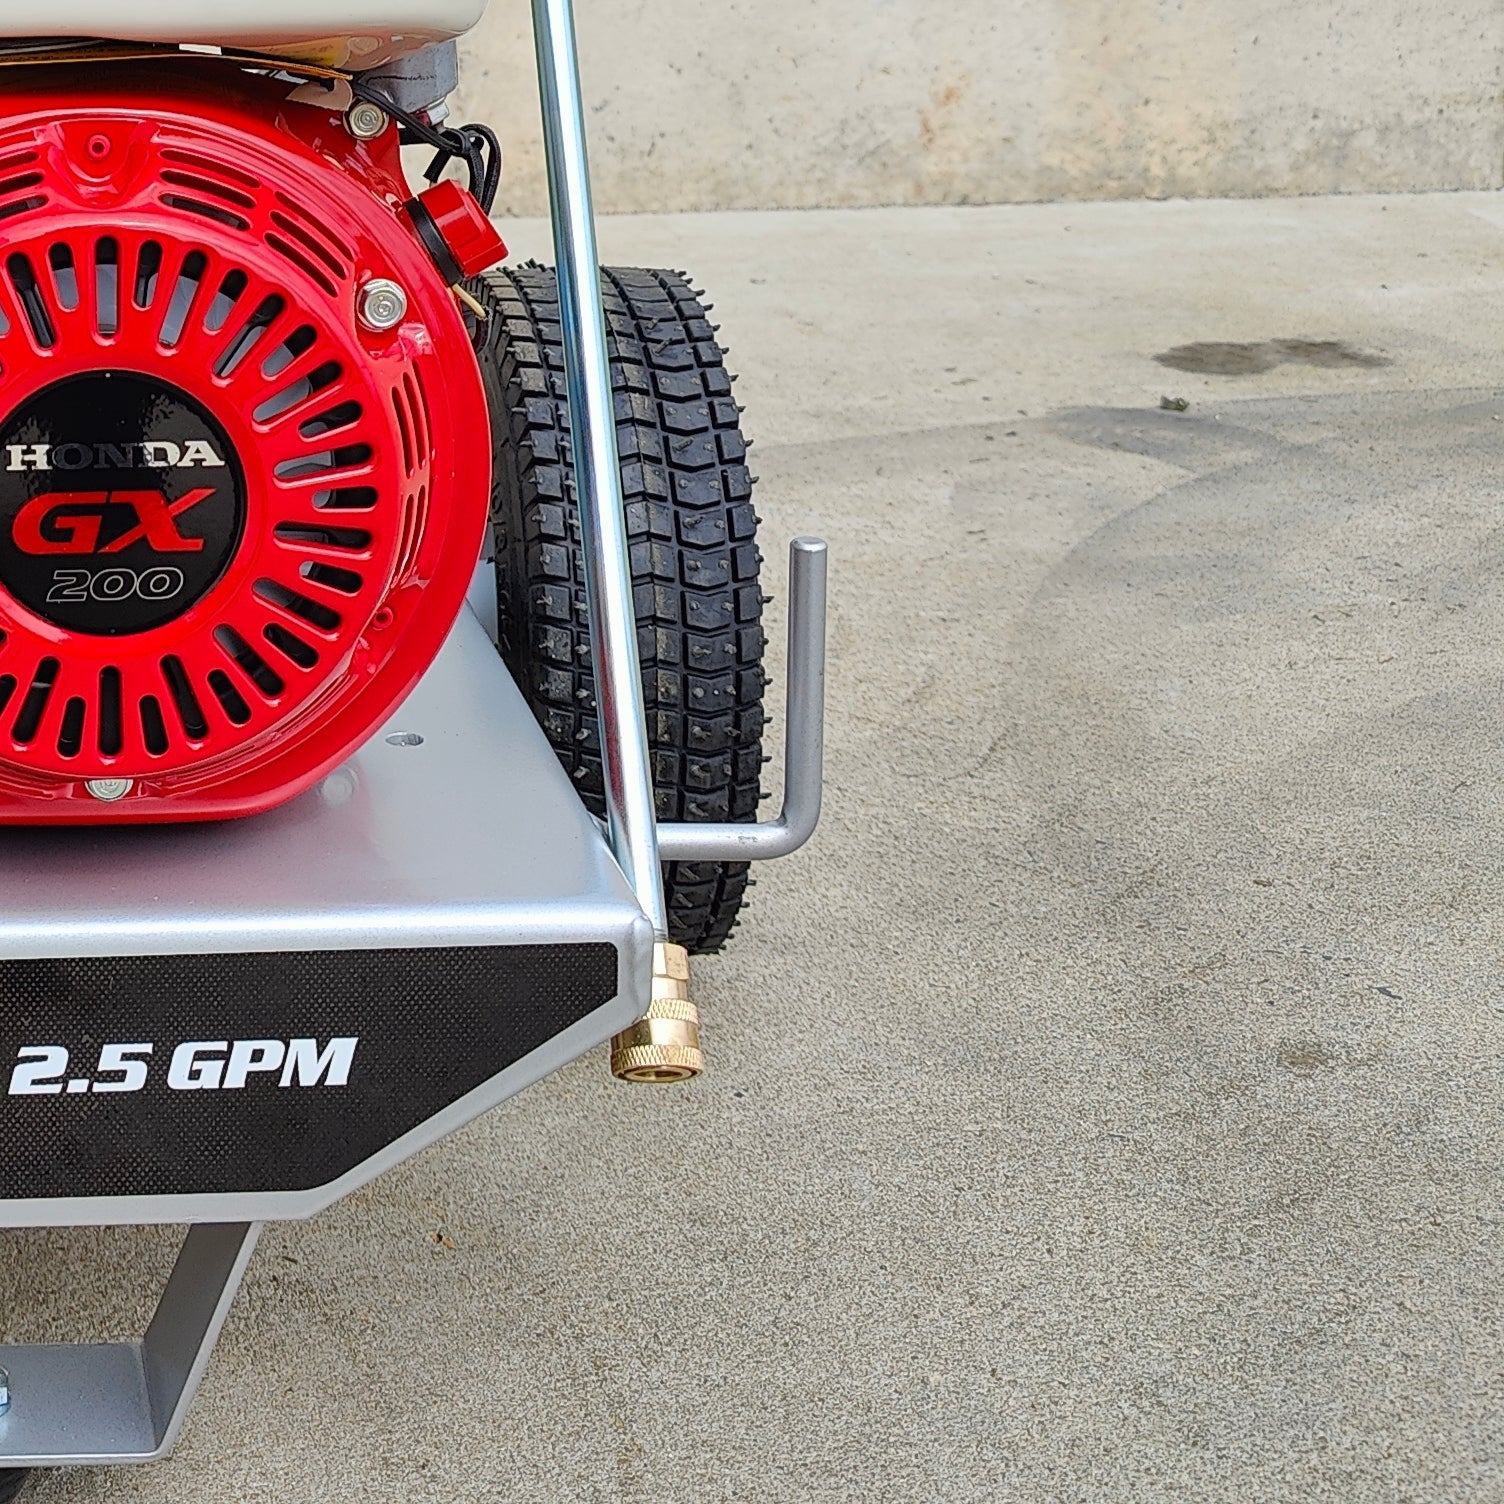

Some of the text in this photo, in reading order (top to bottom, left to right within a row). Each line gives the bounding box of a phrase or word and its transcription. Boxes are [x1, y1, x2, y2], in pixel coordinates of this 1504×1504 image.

[6, 440, 225, 472] HONDA
[12, 488, 217, 555] GX
[46, 567, 184, 603] 200
[8, 1043, 153, 1095] 2.5
[168, 1037, 359, 1090] GPM
